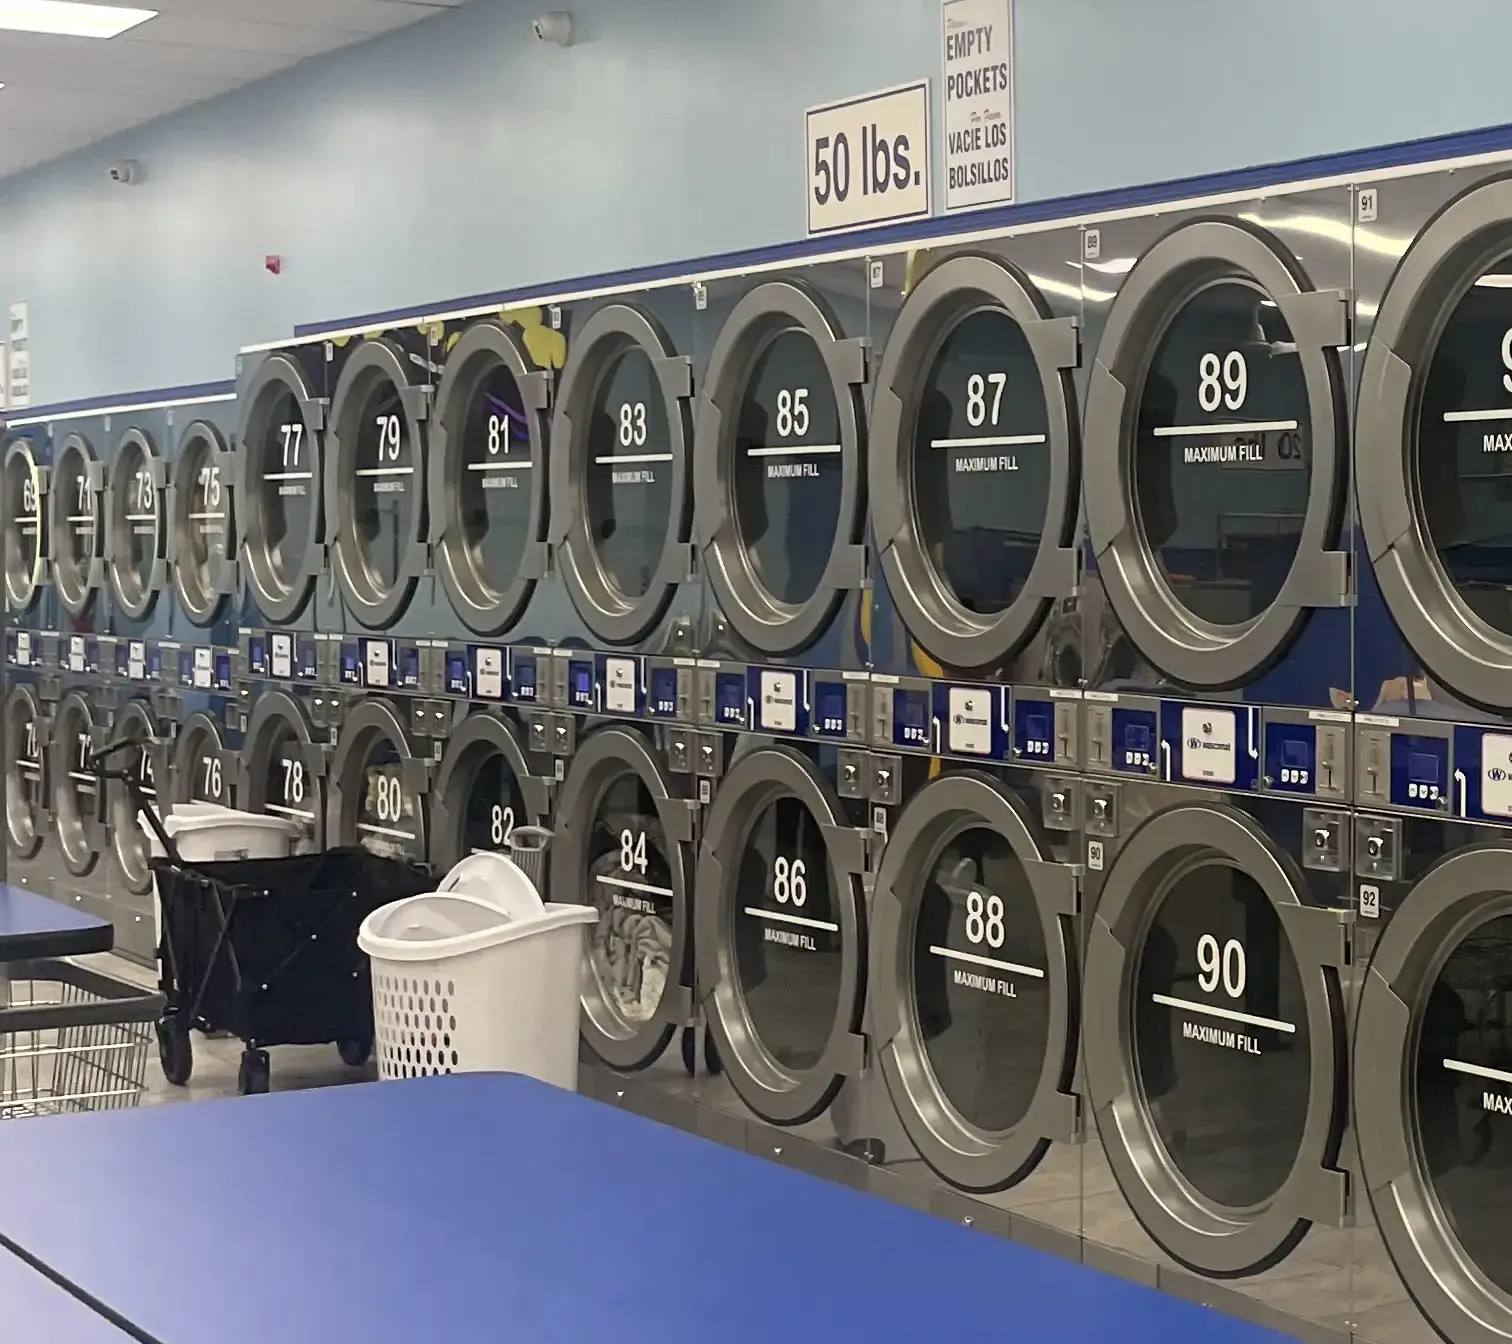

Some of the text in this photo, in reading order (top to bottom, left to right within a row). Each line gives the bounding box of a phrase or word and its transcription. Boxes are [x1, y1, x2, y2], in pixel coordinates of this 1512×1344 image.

[947, 25, 993, 61] EMPTY
[947, 63, 1008, 102] POCKETS
[949, 122, 1007, 155] VACIE LOS
[814, 123, 921, 206] 50 lbs.
[949, 158, 1009, 189] BOLSILLOS
[1361, 195, 1373, 211] 91
[966, 373, 1007, 427] 87
[1198, 350, 1248, 412] 89
[620, 402, 647, 447] 83
[777, 388, 810, 437] 85
[280, 424, 303, 466] 77
[376, 415, 401, 463] 79
[488, 414, 510, 455] 81
[1184, 446, 1237, 463] MAXIMUM
[1239, 444, 1264, 461] FILL
[999, 456, 1019, 472] FILL
[136, 471, 152, 509] 73
[202, 467, 221, 506] 75
[203, 756, 223, 798] 76
[281, 759, 304, 803] 78
[376, 775, 402, 823] 80
[491, 805, 515, 846] 82
[620, 829, 649, 875] 84
[774, 856, 807, 907] 86
[1363, 890, 1376, 907] 92
[965, 891, 1005, 949] 88
[953, 970, 1017, 999] MAXIMUM FILL
[1197, 933, 1246, 998] 90
[1183, 1021, 1262, 1055] MAXIMUM FILL
